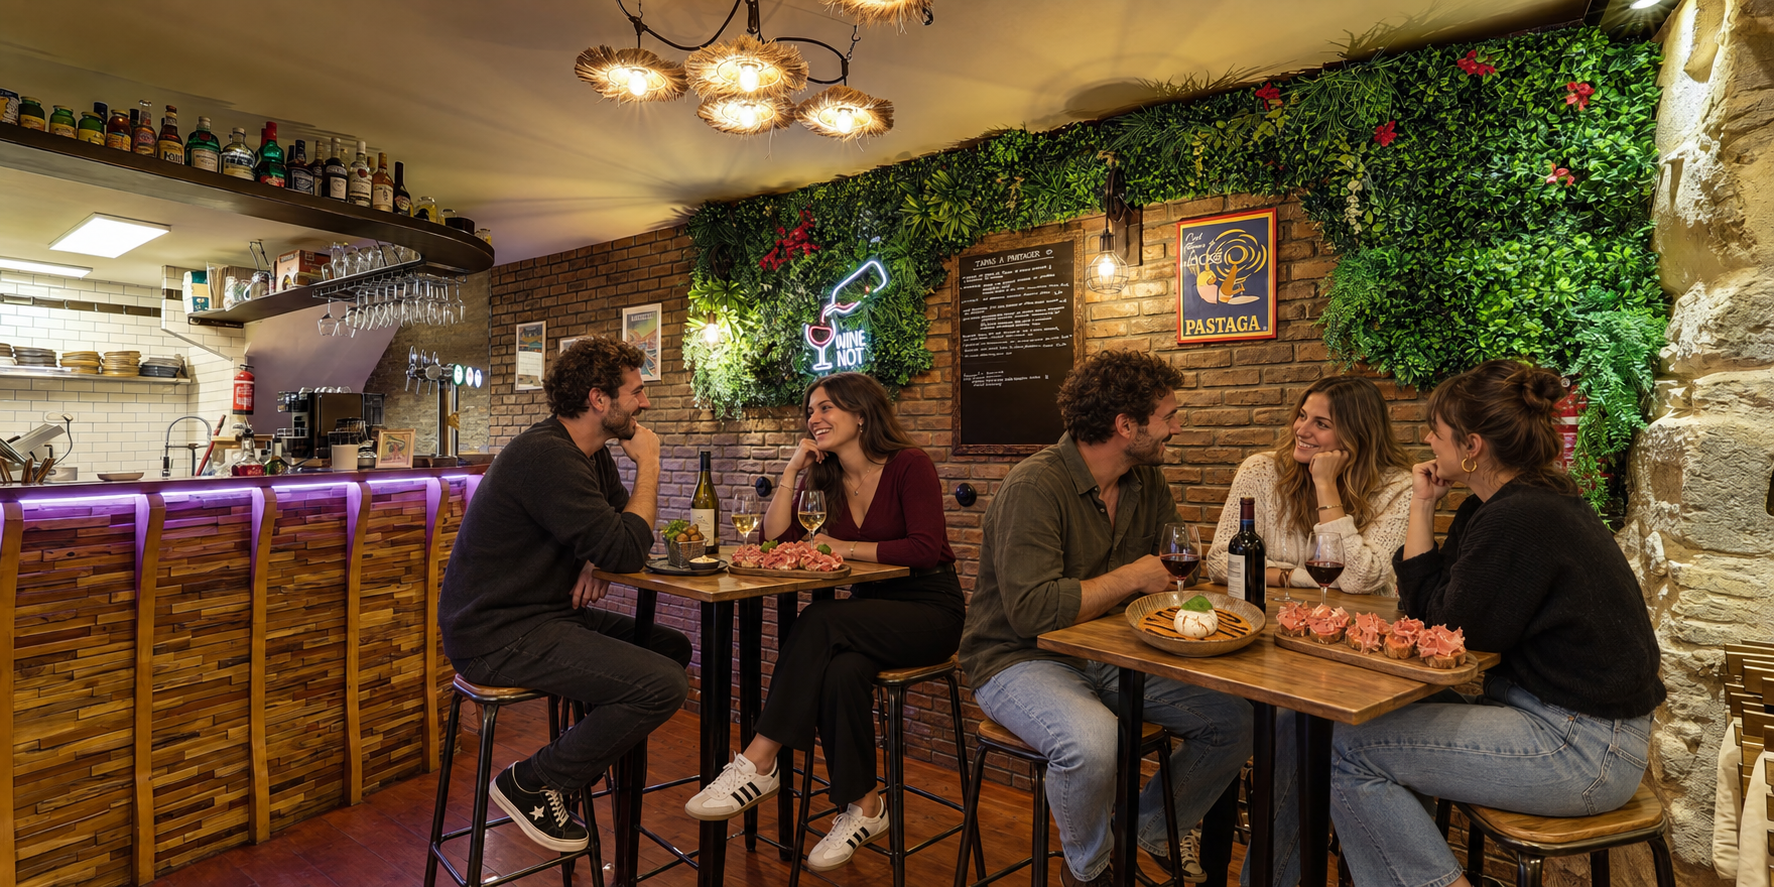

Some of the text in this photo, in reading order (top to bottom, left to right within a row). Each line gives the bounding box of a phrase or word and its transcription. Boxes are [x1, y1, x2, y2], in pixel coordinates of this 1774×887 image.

[1185, 315, 1261, 335] PASTAGA
[835, 330, 866, 350] WINE
[836, 347, 865, 367] NOT
